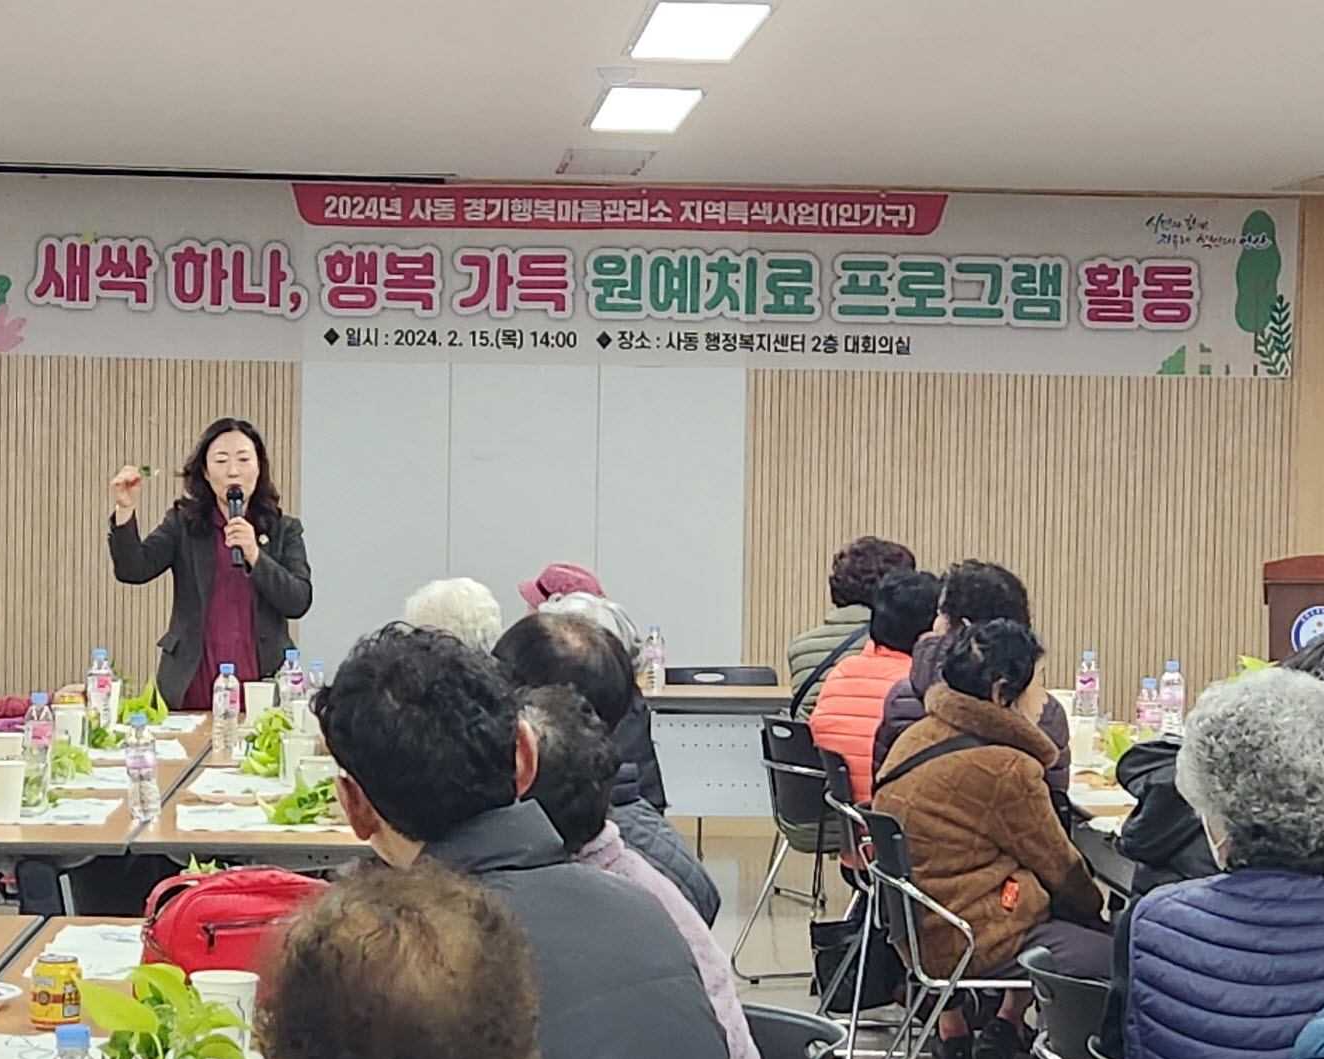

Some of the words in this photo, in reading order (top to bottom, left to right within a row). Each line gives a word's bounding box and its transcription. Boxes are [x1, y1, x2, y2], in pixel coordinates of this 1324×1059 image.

[324, 195, 402, 221] 2024년
[409, 198, 455, 221] 사동
[464, 198, 673, 223] 경기행복마을관리소
[679, 200, 915, 228] 지역특색사업(1인가구)
[34, 242, 153, 304] 새싹
[171, 246, 302, 313] 하나,
[324, 250, 436, 311] 행복
[459, 253, 569, 312] 가득
[592, 256, 814, 315] 원예치료
[839, 262, 1061, 321] 프로그램
[1084, 263, 1194, 324] 활동
[345, 327, 379, 347] 일시
[394, 329, 442, 347] 2024.
[447, 330, 463, 347] 2.
[469, 327, 524, 350] 15.(목)
[530, 330, 577, 349] 14:00
[617, 330, 652, 350] 장소
[665, 331, 699, 352] 사동
[704, 331, 806, 354] 행정복지센터
[811, 334, 840, 354] 2층
[844, 334, 911, 356] 대회의실
